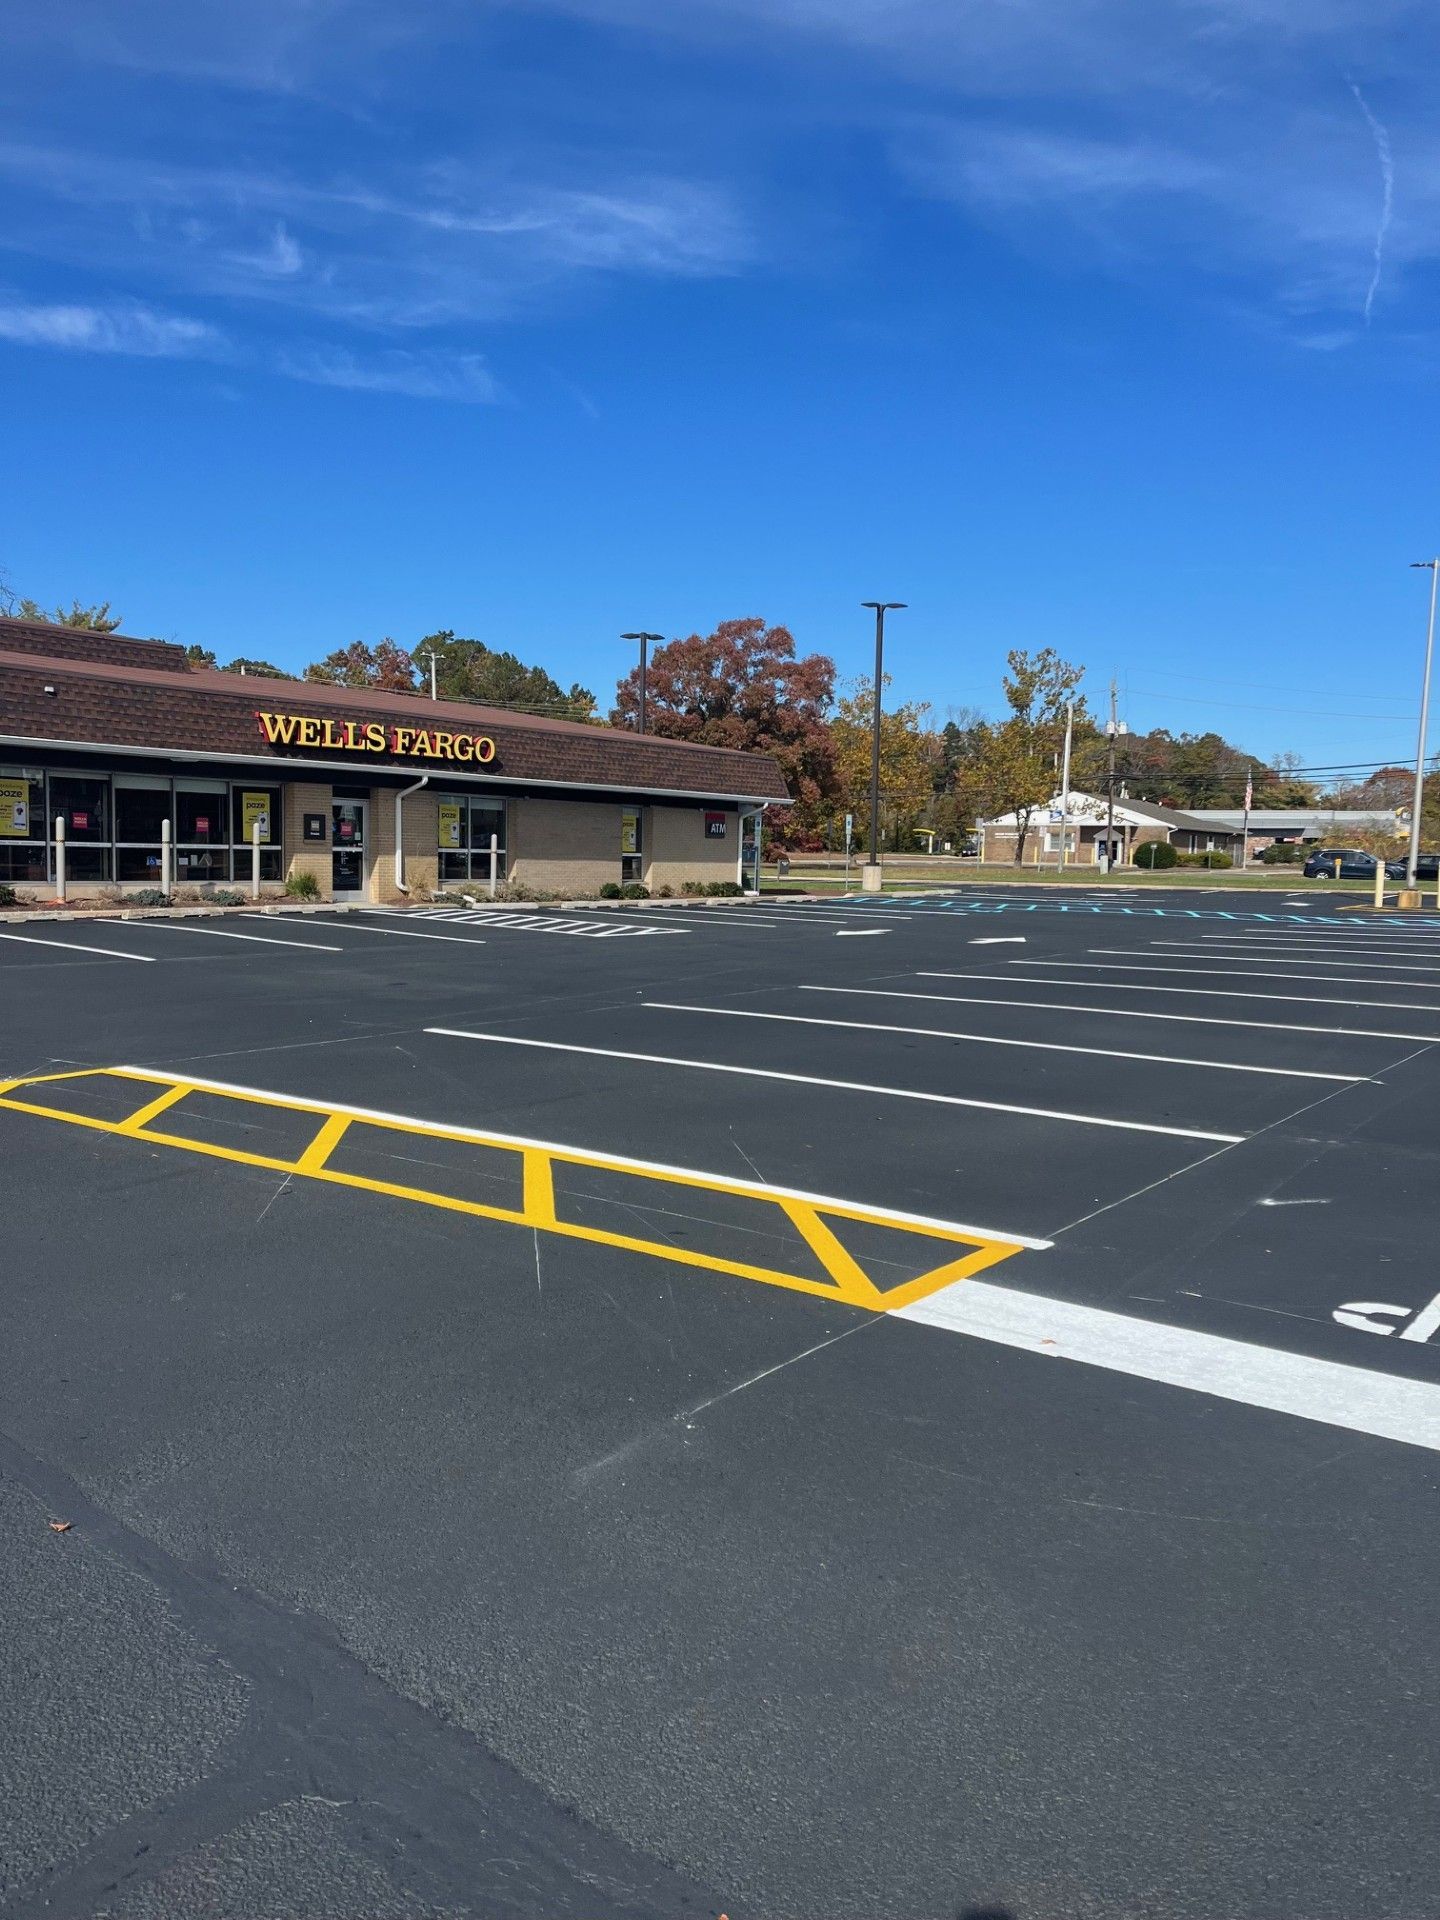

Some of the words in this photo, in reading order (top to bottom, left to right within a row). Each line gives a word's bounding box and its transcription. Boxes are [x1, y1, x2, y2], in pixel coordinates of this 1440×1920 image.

[256, 711, 386, 752] WELLS
[392, 727, 496, 763] FARGO
[710, 823, 727, 833] ATM
